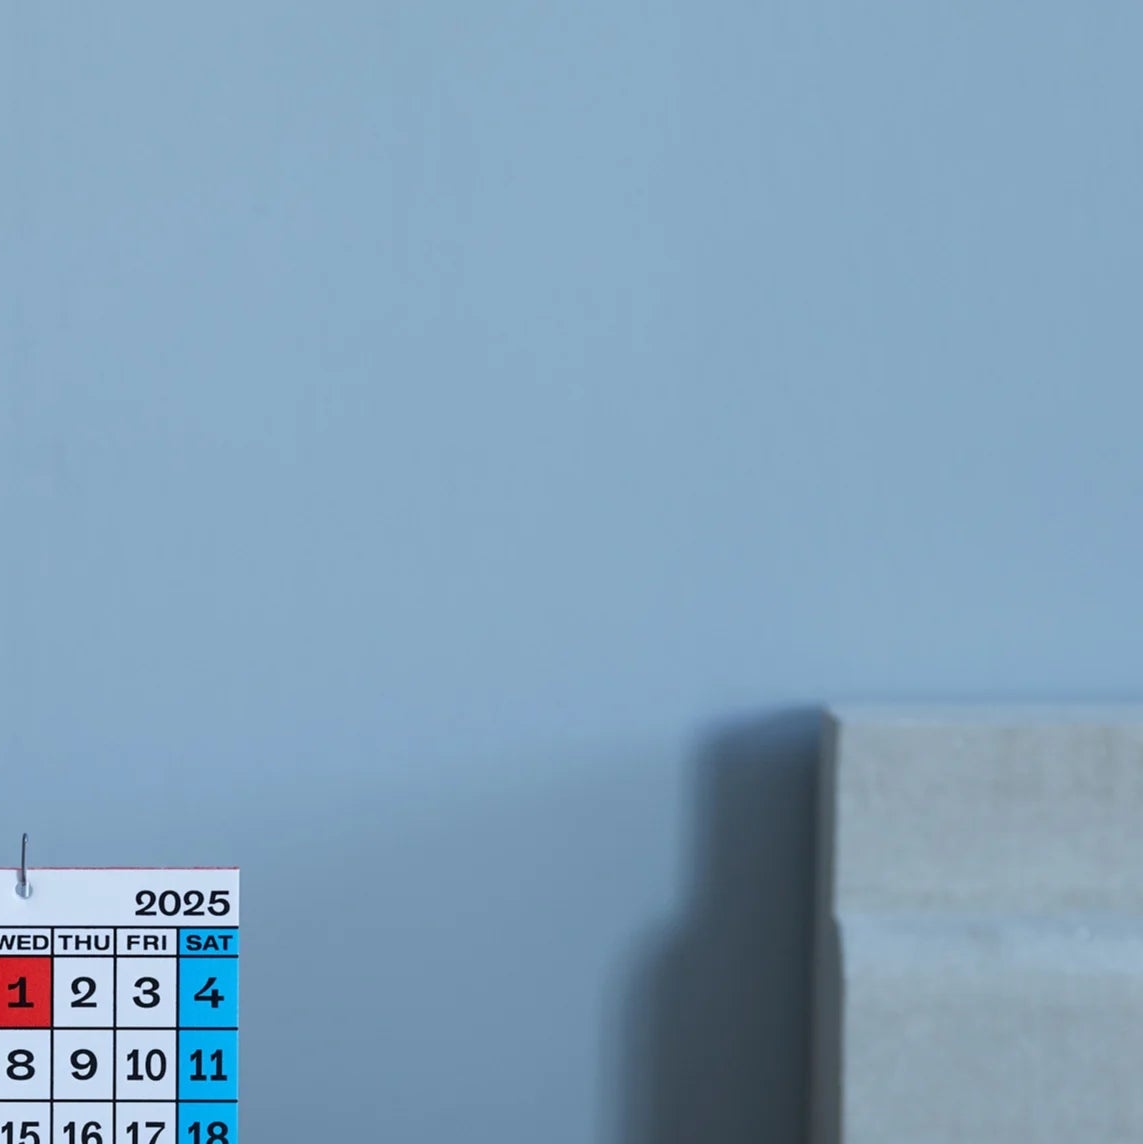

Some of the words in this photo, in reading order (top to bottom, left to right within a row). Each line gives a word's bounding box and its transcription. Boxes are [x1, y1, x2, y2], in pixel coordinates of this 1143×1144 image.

[135, 890, 230, 916] 2025
[57, 935, 110, 951] THU
[127, 935, 167, 951] FRI
[186, 934, 233, 951] SAT
[7, 976, 34, 1008] 1
[70, 976, 97, 1008] 2
[132, 976, 161, 1009] 3
[194, 977, 225, 1008] 4
[6, 1049, 35, 1081] 8
[70, 1048, 98, 1081] 9
[127, 1048, 167, 1081] 10
[190, 1049, 227, 1081] 11
